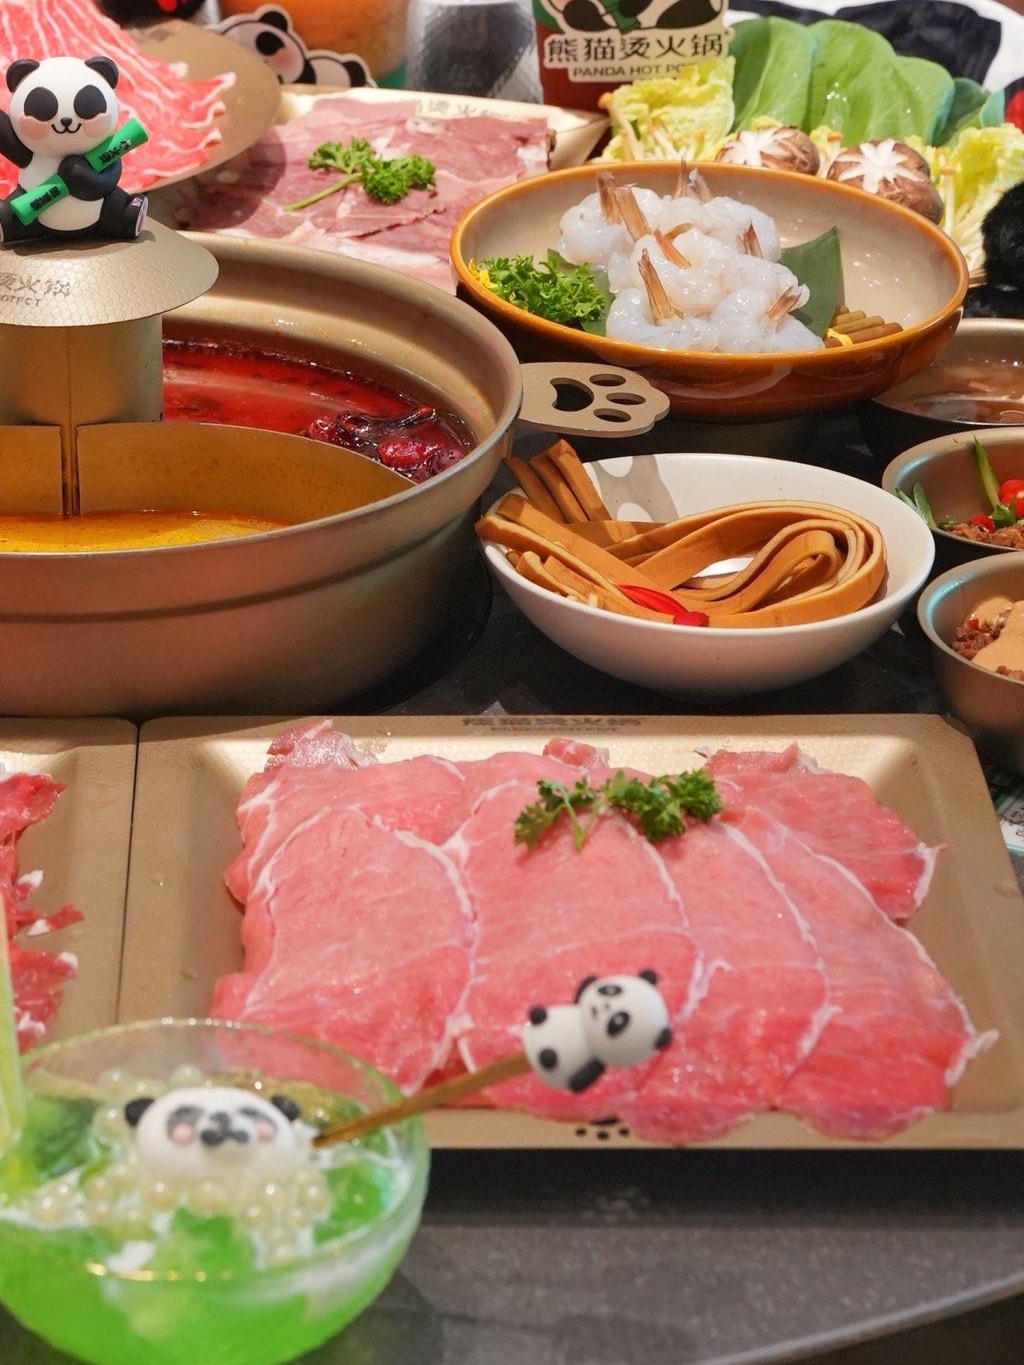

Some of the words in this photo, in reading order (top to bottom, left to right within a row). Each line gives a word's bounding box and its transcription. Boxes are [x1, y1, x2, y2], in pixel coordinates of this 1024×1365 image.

[548, 33, 723, 63] 熊猫烫火锅
[573, 67, 625, 78] PANDA
[631, 65, 661, 76] HOT
